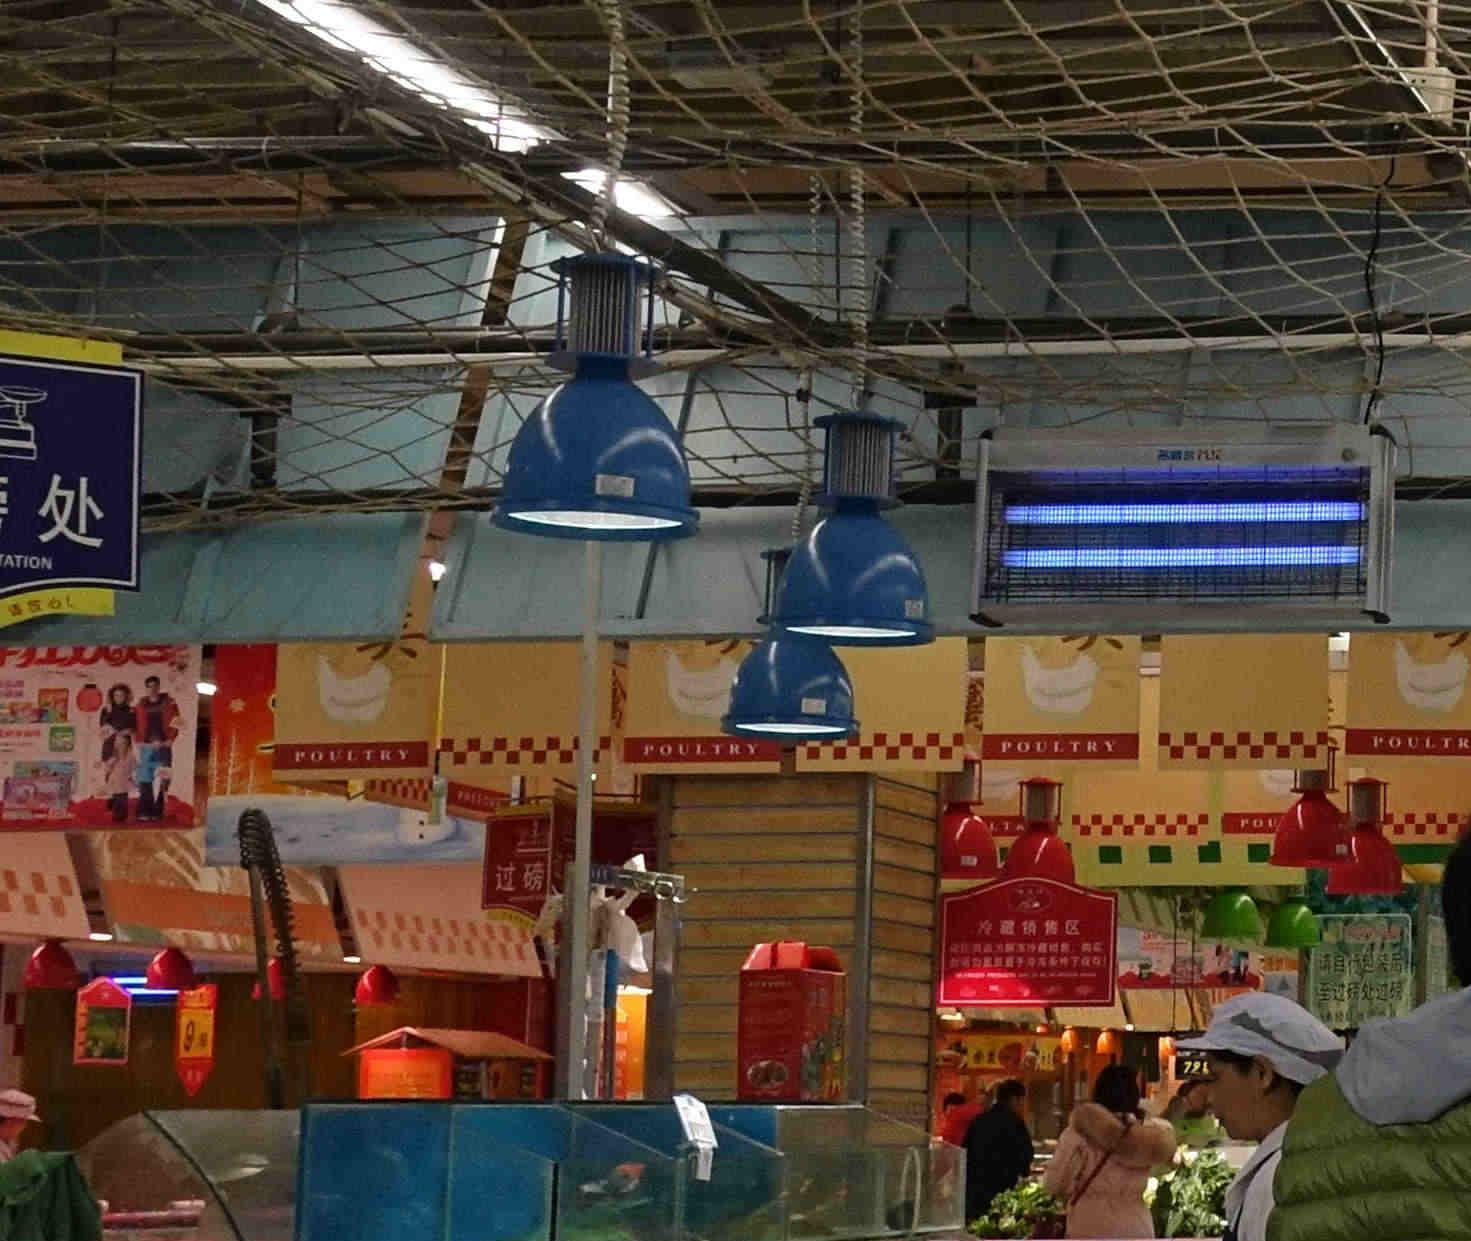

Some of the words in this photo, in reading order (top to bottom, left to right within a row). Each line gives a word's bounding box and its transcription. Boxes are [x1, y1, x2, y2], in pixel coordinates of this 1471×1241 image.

[643, 743, 759, 757] POULTRY
[1001, 740, 1117, 753] POULTRY
[295, 748, 410, 763] POULTRY
[495, 862, 545, 891] 过磅
